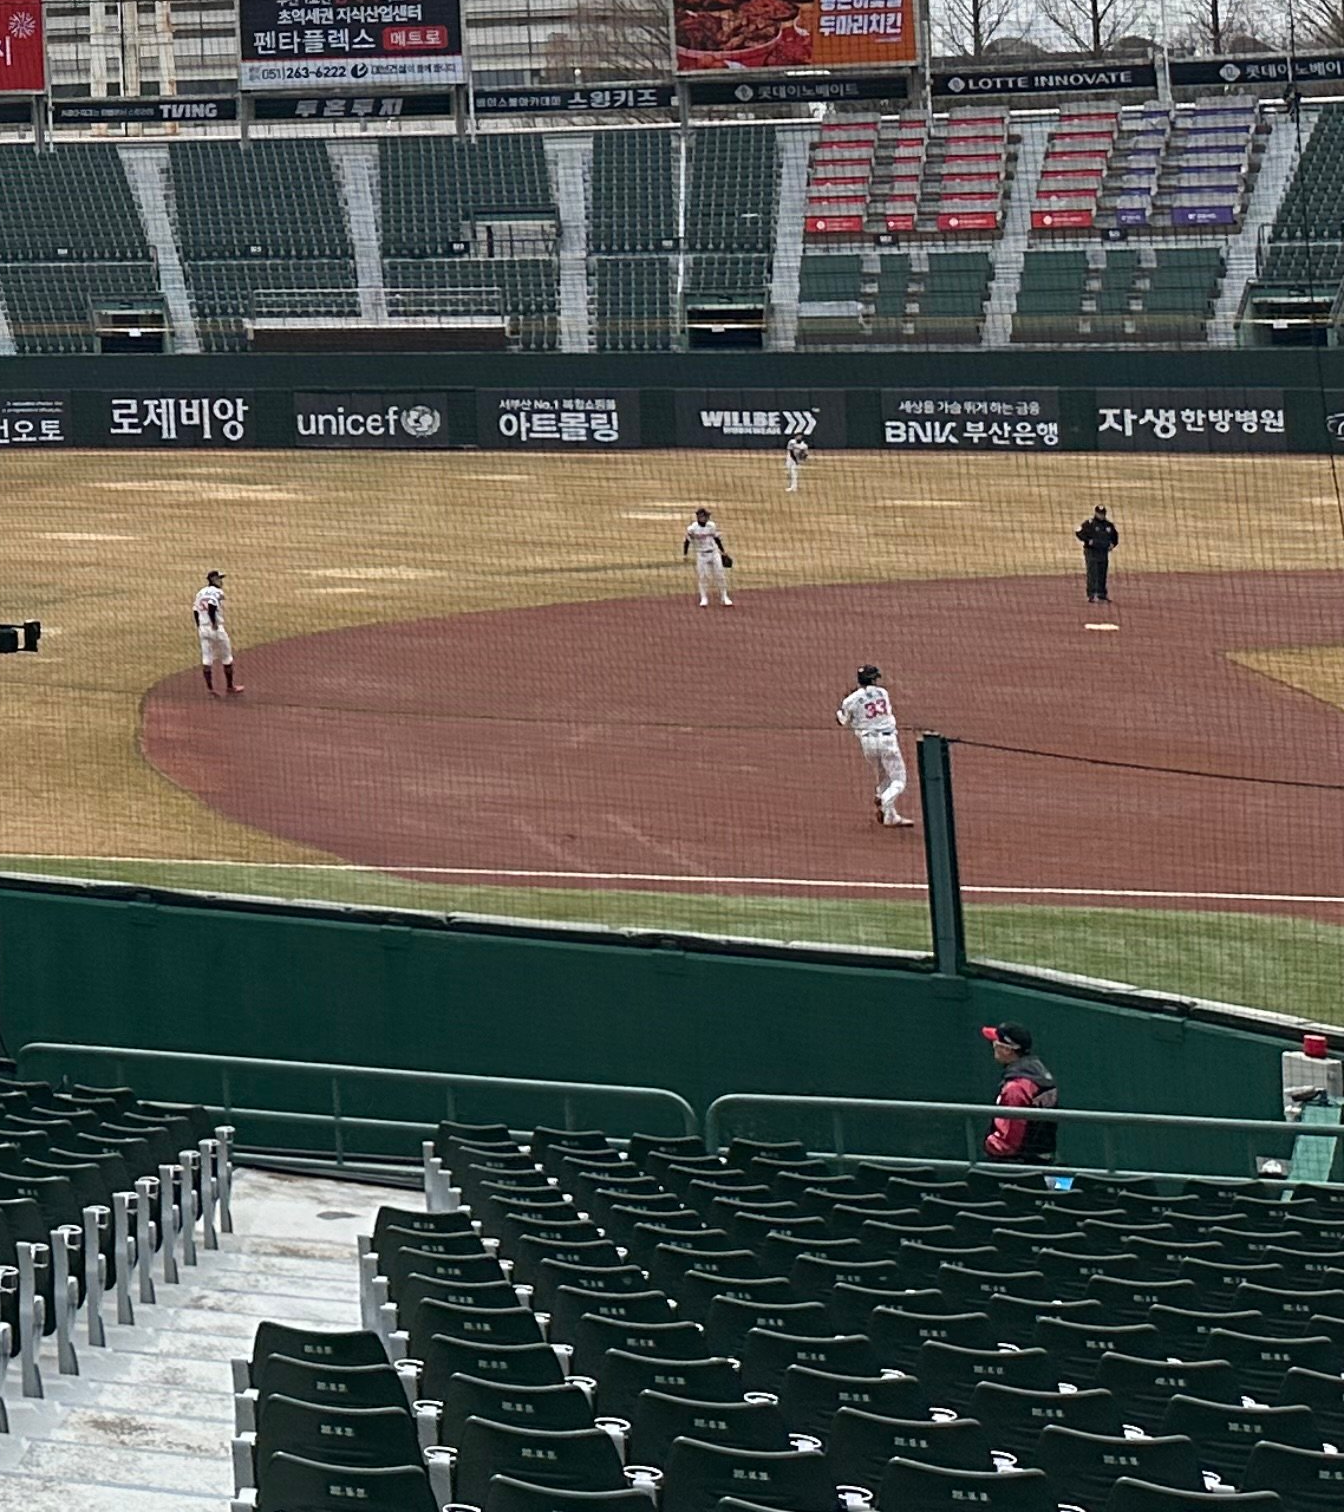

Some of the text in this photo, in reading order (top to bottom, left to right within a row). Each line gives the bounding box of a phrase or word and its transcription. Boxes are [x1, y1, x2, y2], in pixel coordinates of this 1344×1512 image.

[277, 4, 422, 26] 초역세권 지식산업센터
[819, 12, 902, 36] 두마리치킨
[253, 28, 441, 55] 펜타플렉스 메트로
[968, 71, 1133, 90] LOTTE INNOVATE
[567, 89, 657, 109] 스윙키즈
[758, 84, 859, 99] 롯데이노베이트
[159, 103, 218, 118] TVING
[534, 399, 558, 410] No.1
[898, 399, 1040, 416] 세상을 가슴 뛰게 하는 금융
[110, 398, 249, 440] 로제비앙
[297, 406, 400, 436] unicef
[499, 411, 619, 442] 아트몰링
[700, 410, 781, 428] WILLBE
[1098, 407, 1285, 440] 자생한방병원
[885, 421, 1059, 446] BNK 부산은행
[864, 699, 887, 719] 33
